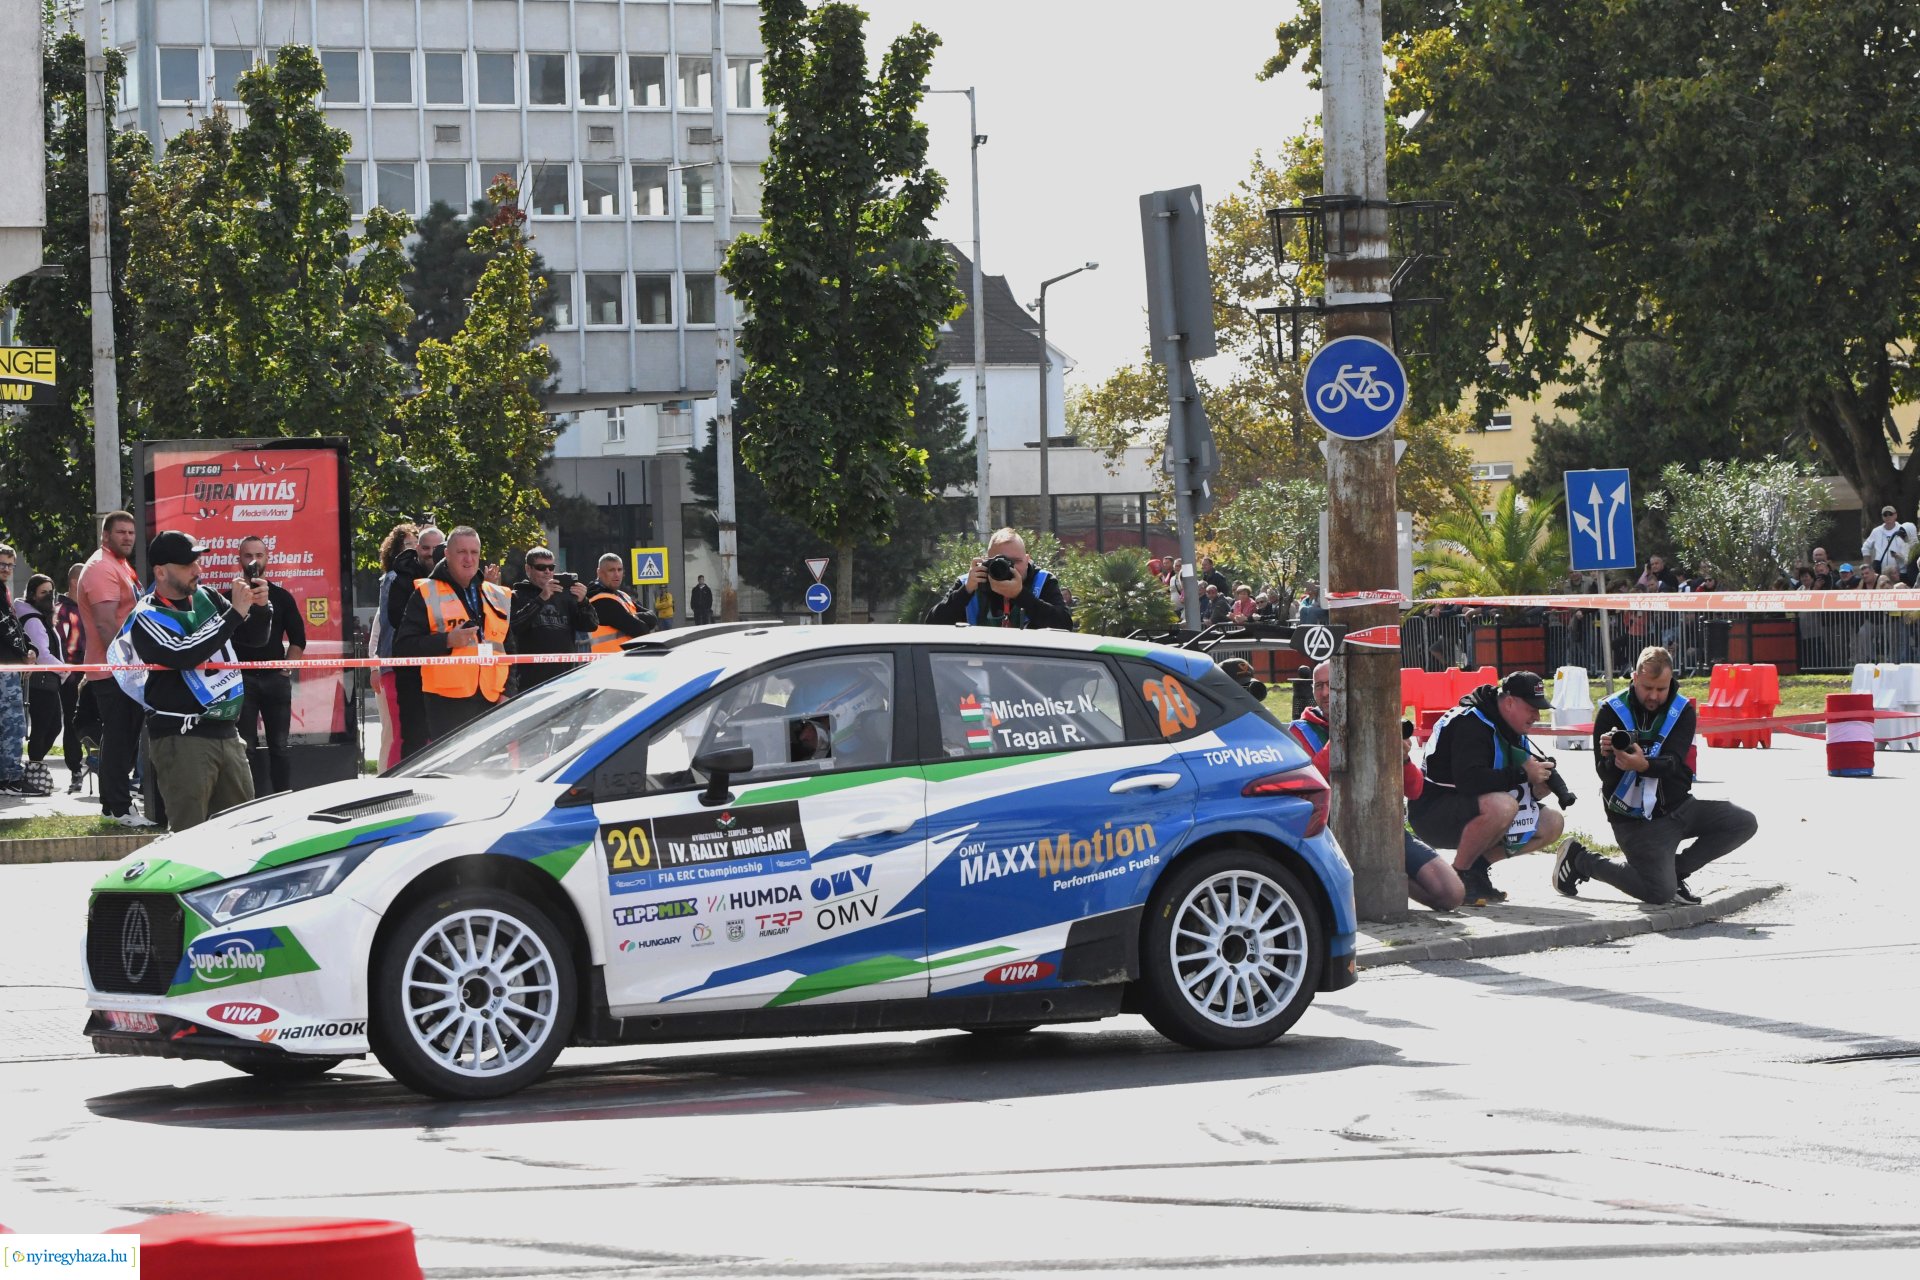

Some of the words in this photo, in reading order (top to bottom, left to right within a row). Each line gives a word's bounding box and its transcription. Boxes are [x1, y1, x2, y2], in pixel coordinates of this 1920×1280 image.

[186, 466, 206, 474] LET'S
[207, 465, 220, 473] GO!
[194, 479, 296, 502] ÚJRANYITÁS
[303, 551, 313, 563] is
[309, 600, 325, 611] RS
[991, 697, 1076, 720] Michelisz
[1077, 694, 1099, 713] N.
[1142, 674, 1197, 737] 20
[998, 727, 1058, 750] Tagai
[1061, 724, 1086, 743] R.
[1511, 817, 1534, 828] PHOTO
[607, 826, 652, 869] 20
[668, 841, 690, 864] IV.
[689, 839, 729, 861] RALLY
[732, 827, 792, 856] HUNGARY
[959, 842, 986, 857] OMV
[658, 872, 675, 884] FIA
[678, 870, 696, 881] ERC
[697, 862, 763, 880] Championship
[1052, 863, 1126, 891] Performance
[1129, 854, 1160, 874] Fuels
[730, 885, 803, 910] HUMDA
[755, 911, 803, 929] TRP
[816, 894, 879, 931] OMV
[638, 935, 682, 949] HUNGARY
[759, 927, 790, 938] HUNGARY
[188, 946, 266, 973] SuperShop
[1000, 963, 1039, 982] VIVA
[222, 1006, 261, 1022] VIVA
